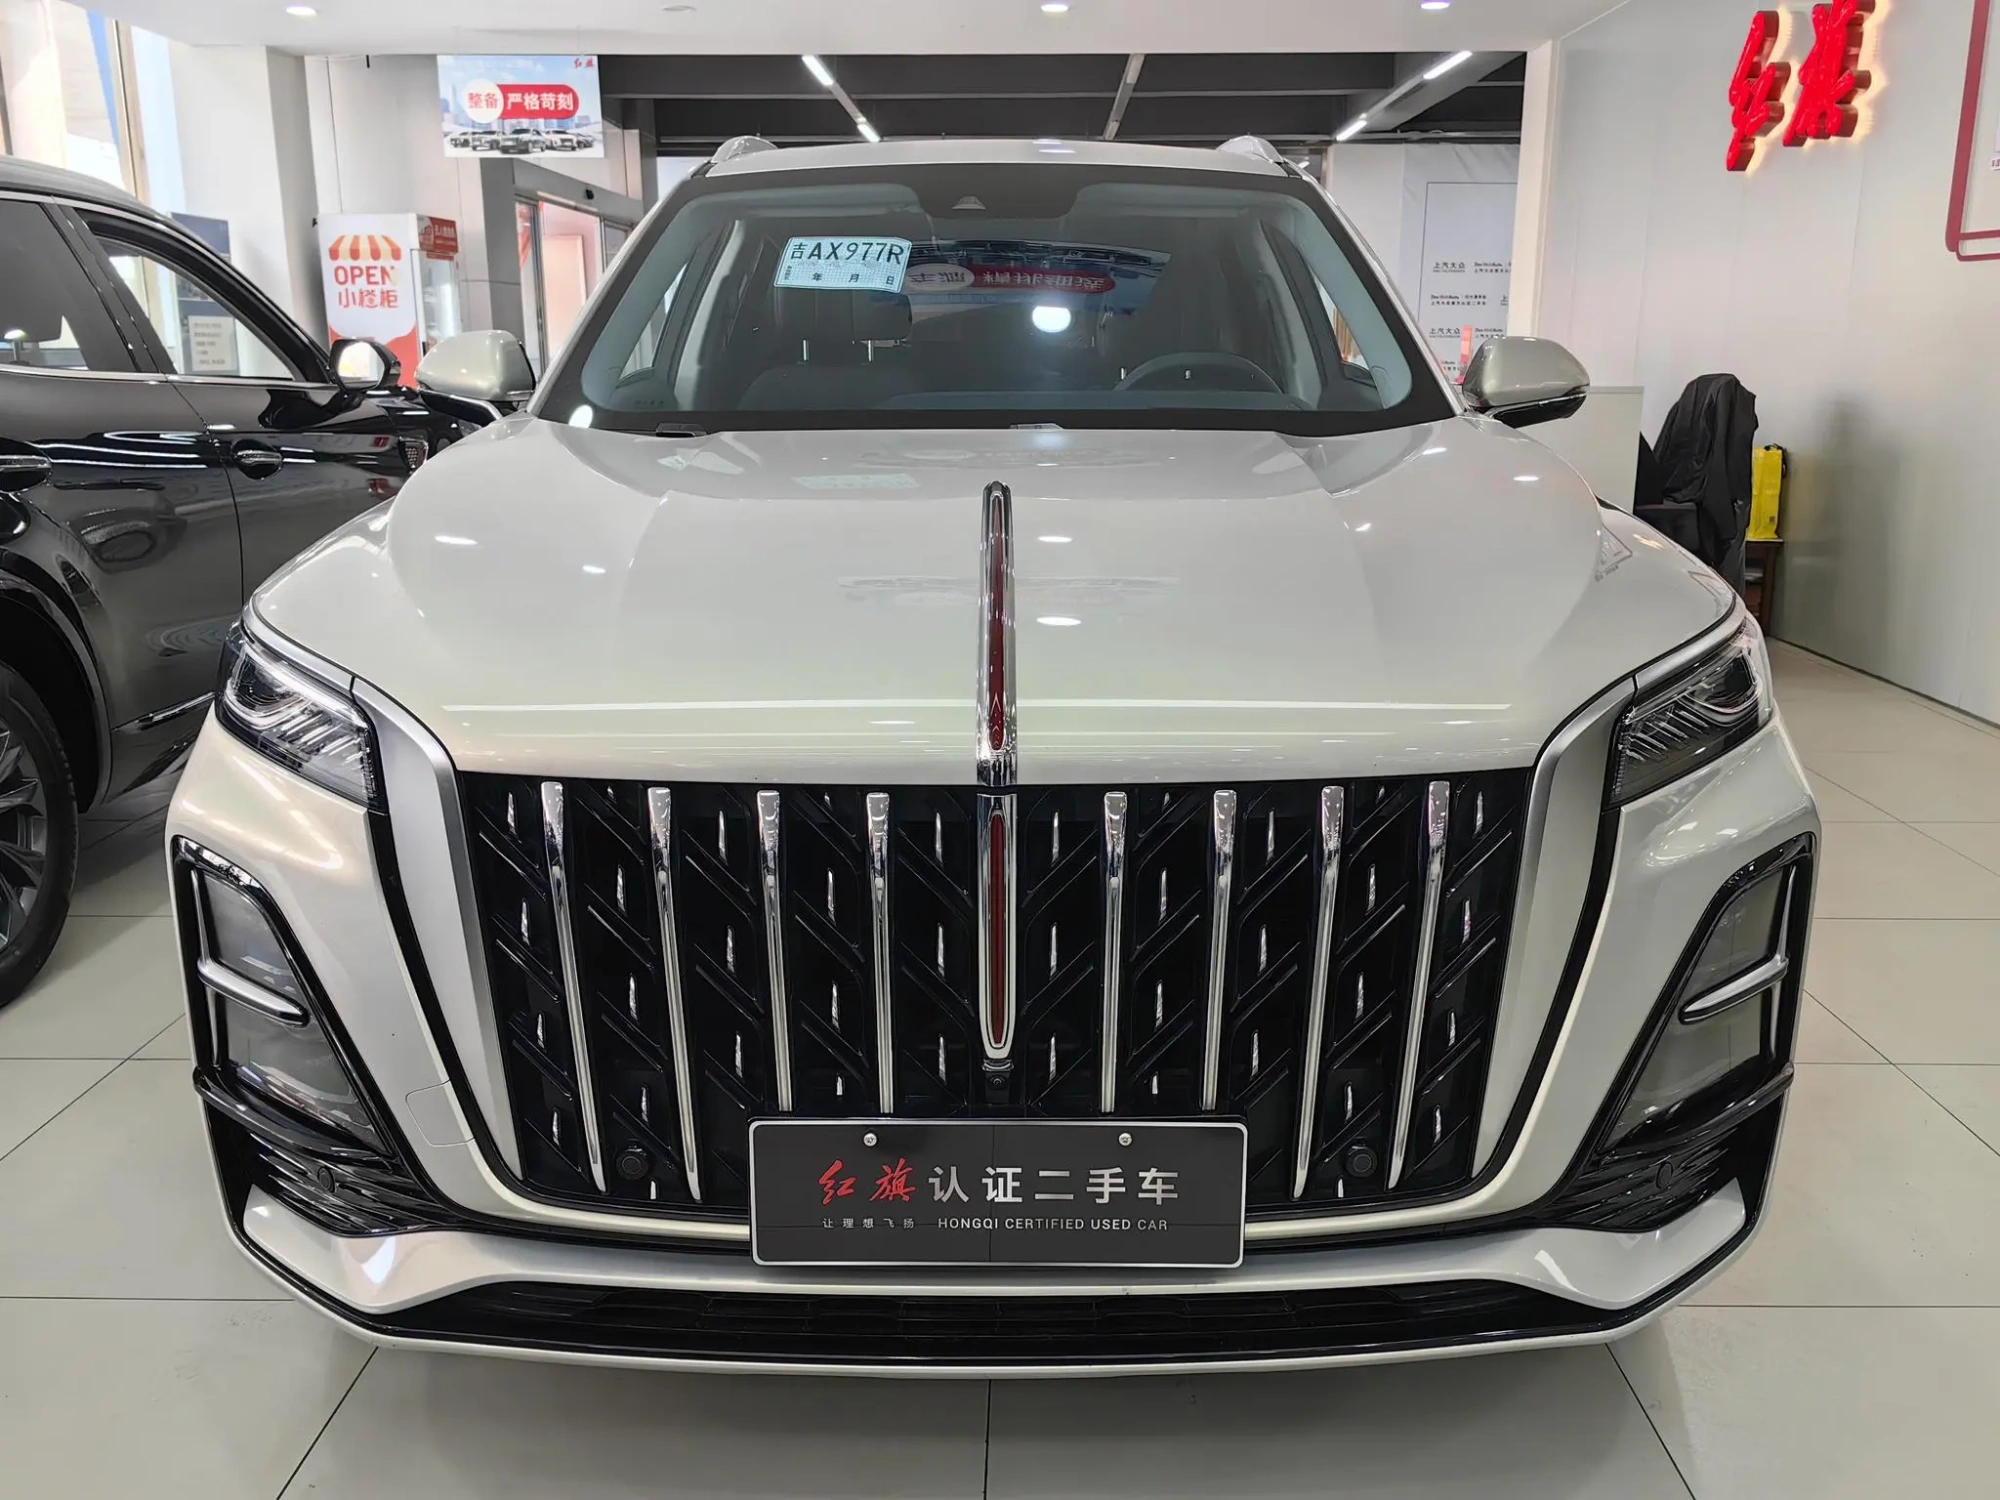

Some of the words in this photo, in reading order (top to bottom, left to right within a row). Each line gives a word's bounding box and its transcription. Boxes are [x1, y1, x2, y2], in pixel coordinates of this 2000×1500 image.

[468, 92, 499, 109] 整备
[506, 92, 574, 111] 严格苛刻
[791, 242, 905, 265] 吉AX977R
[334, 265, 396, 286] OPEN
[848, 273, 860, 283] 月
[886, 276, 895, 285] 日
[822, 1218, 915, 1229] 让理想飞扬
[938, 1217, 999, 1230] HONGQI
[1004, 1217, 1085, 1230] CERTIFIED
[1090, 1218, 1131, 1231] USED
[1137, 1219, 1168, 1232] CAR
